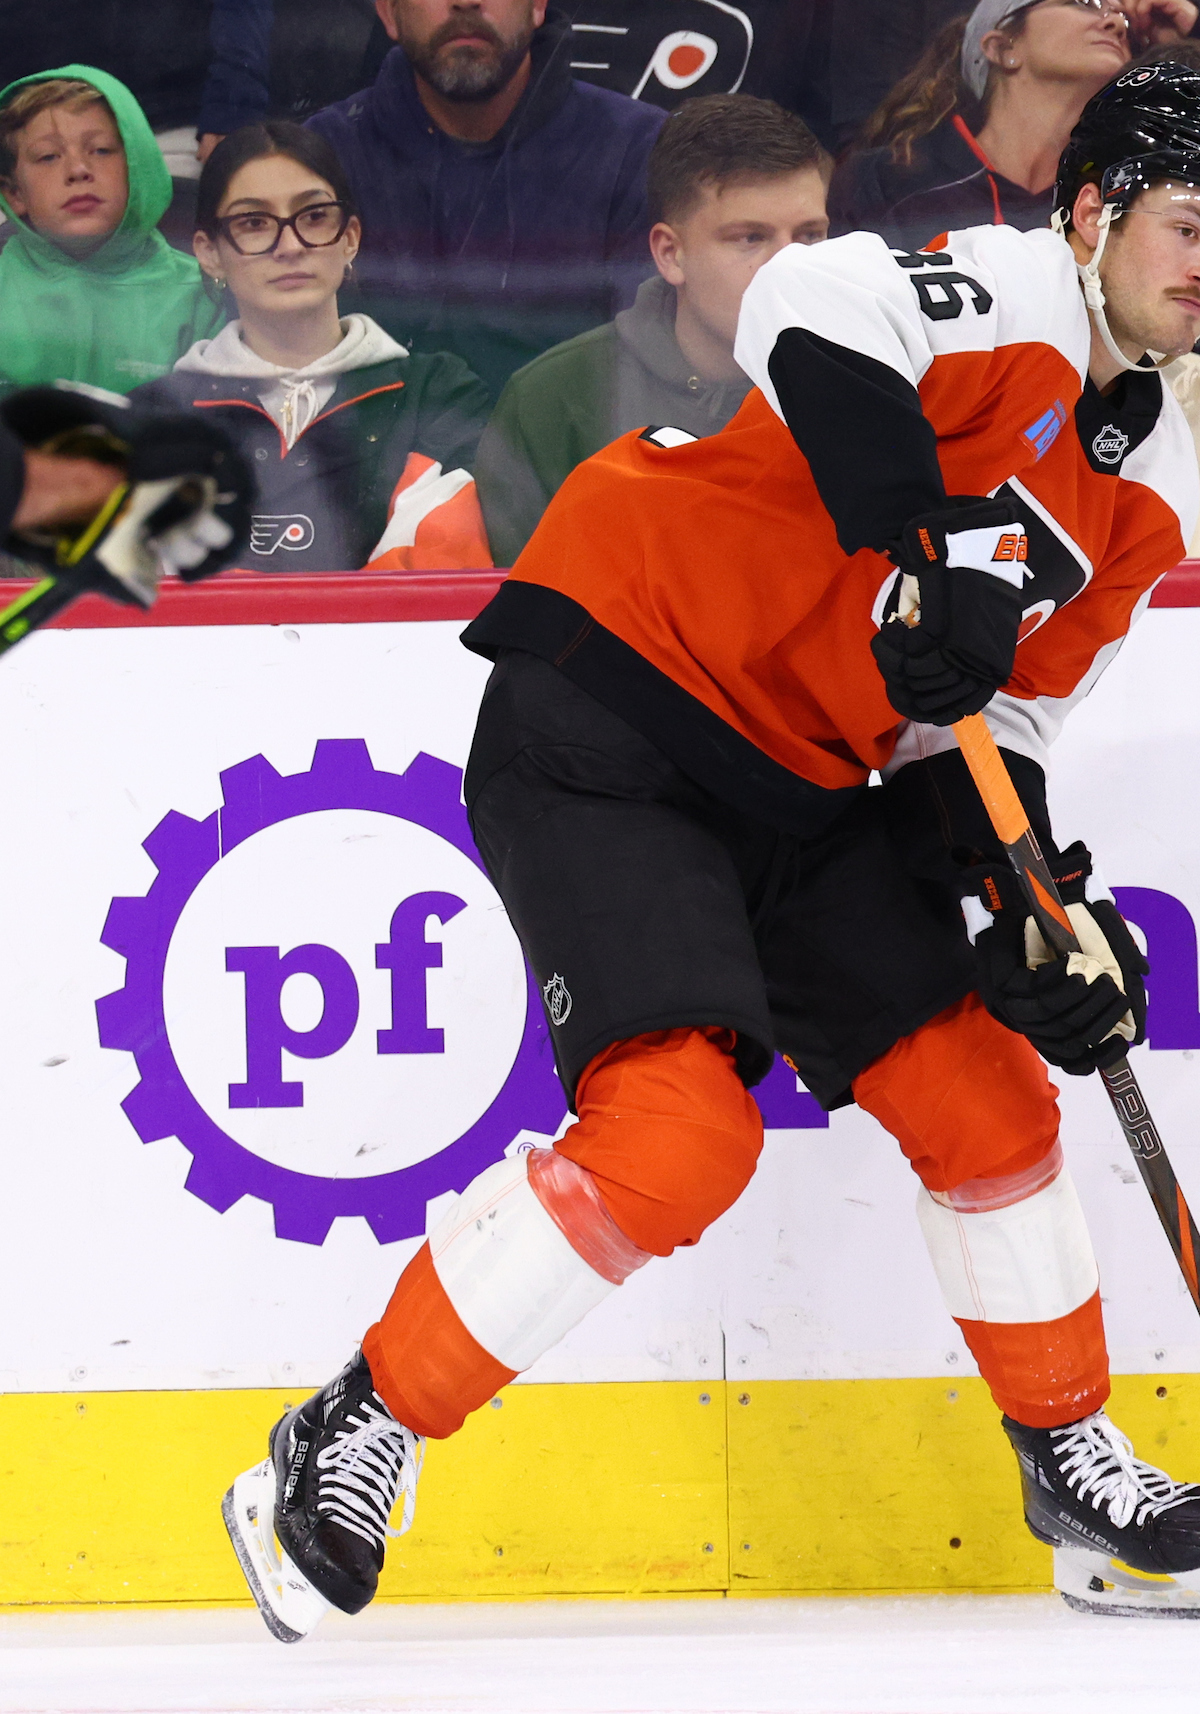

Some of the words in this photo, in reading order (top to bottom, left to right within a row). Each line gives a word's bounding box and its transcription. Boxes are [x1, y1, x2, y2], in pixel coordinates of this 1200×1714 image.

[1098, 441, 1121, 450] NHL
[991, 533, 1029, 562] 86
[225, 890, 468, 1109] pf
